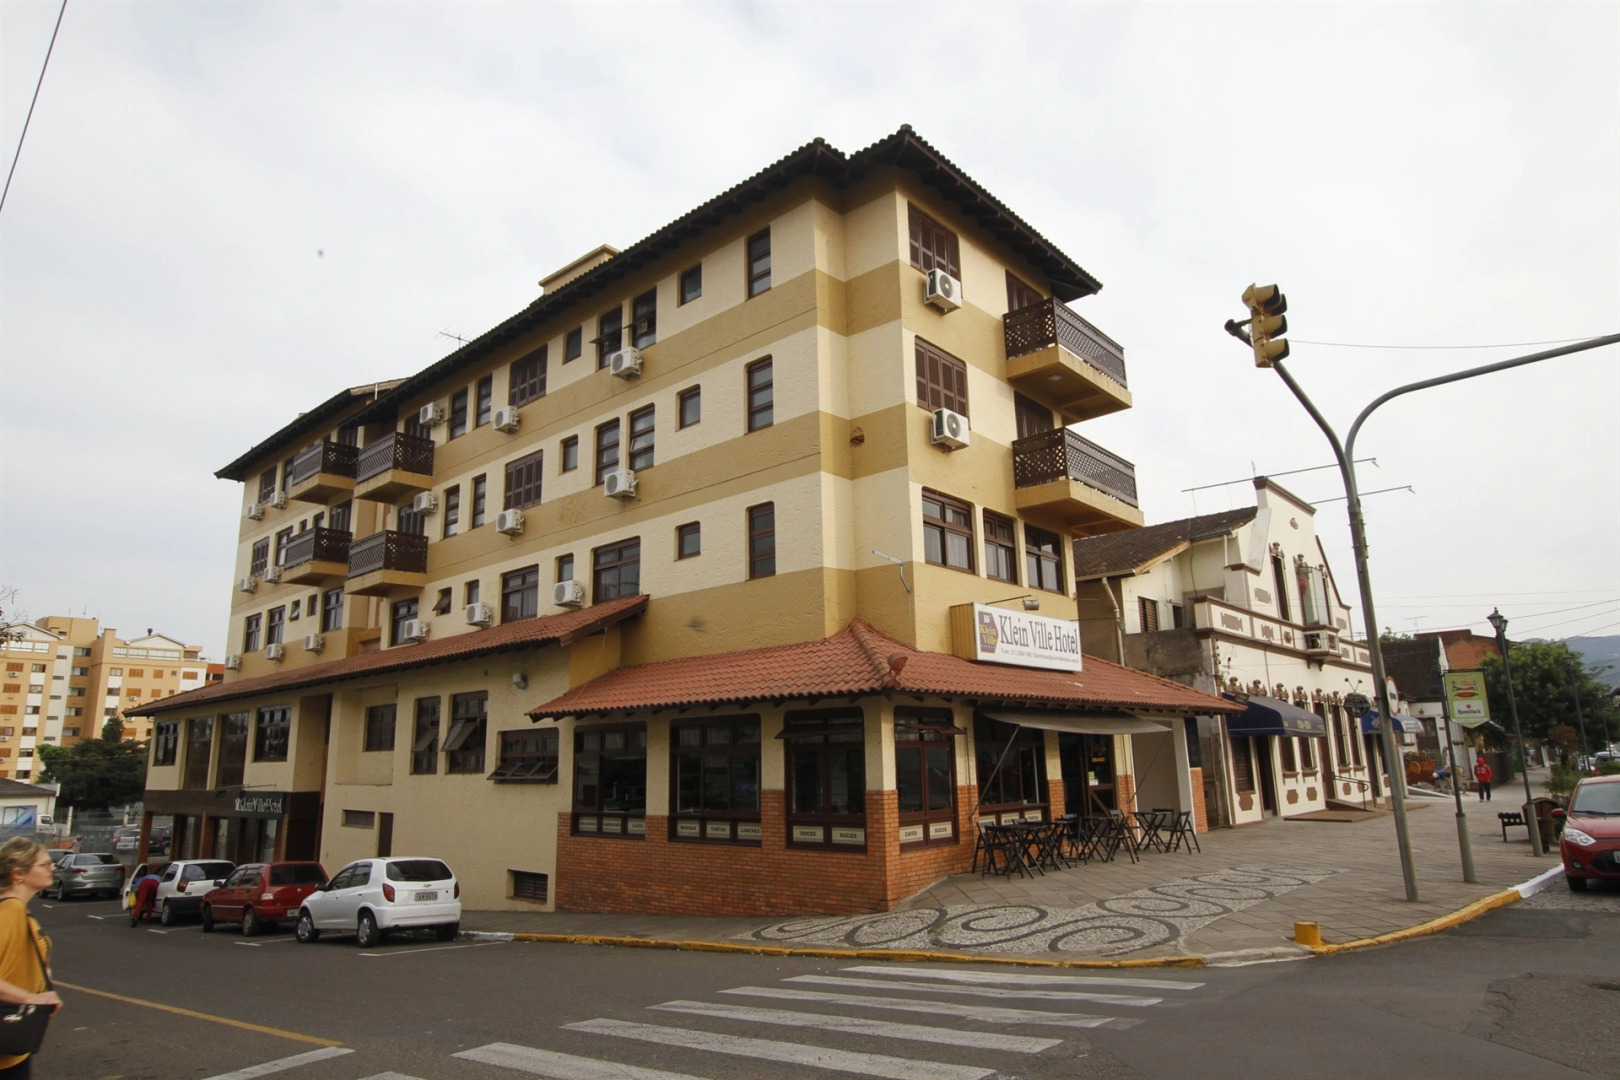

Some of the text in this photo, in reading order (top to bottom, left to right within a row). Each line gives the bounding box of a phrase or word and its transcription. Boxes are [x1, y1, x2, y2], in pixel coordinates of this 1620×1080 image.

[999, 615, 1079, 654] Klein Ville Hotel
